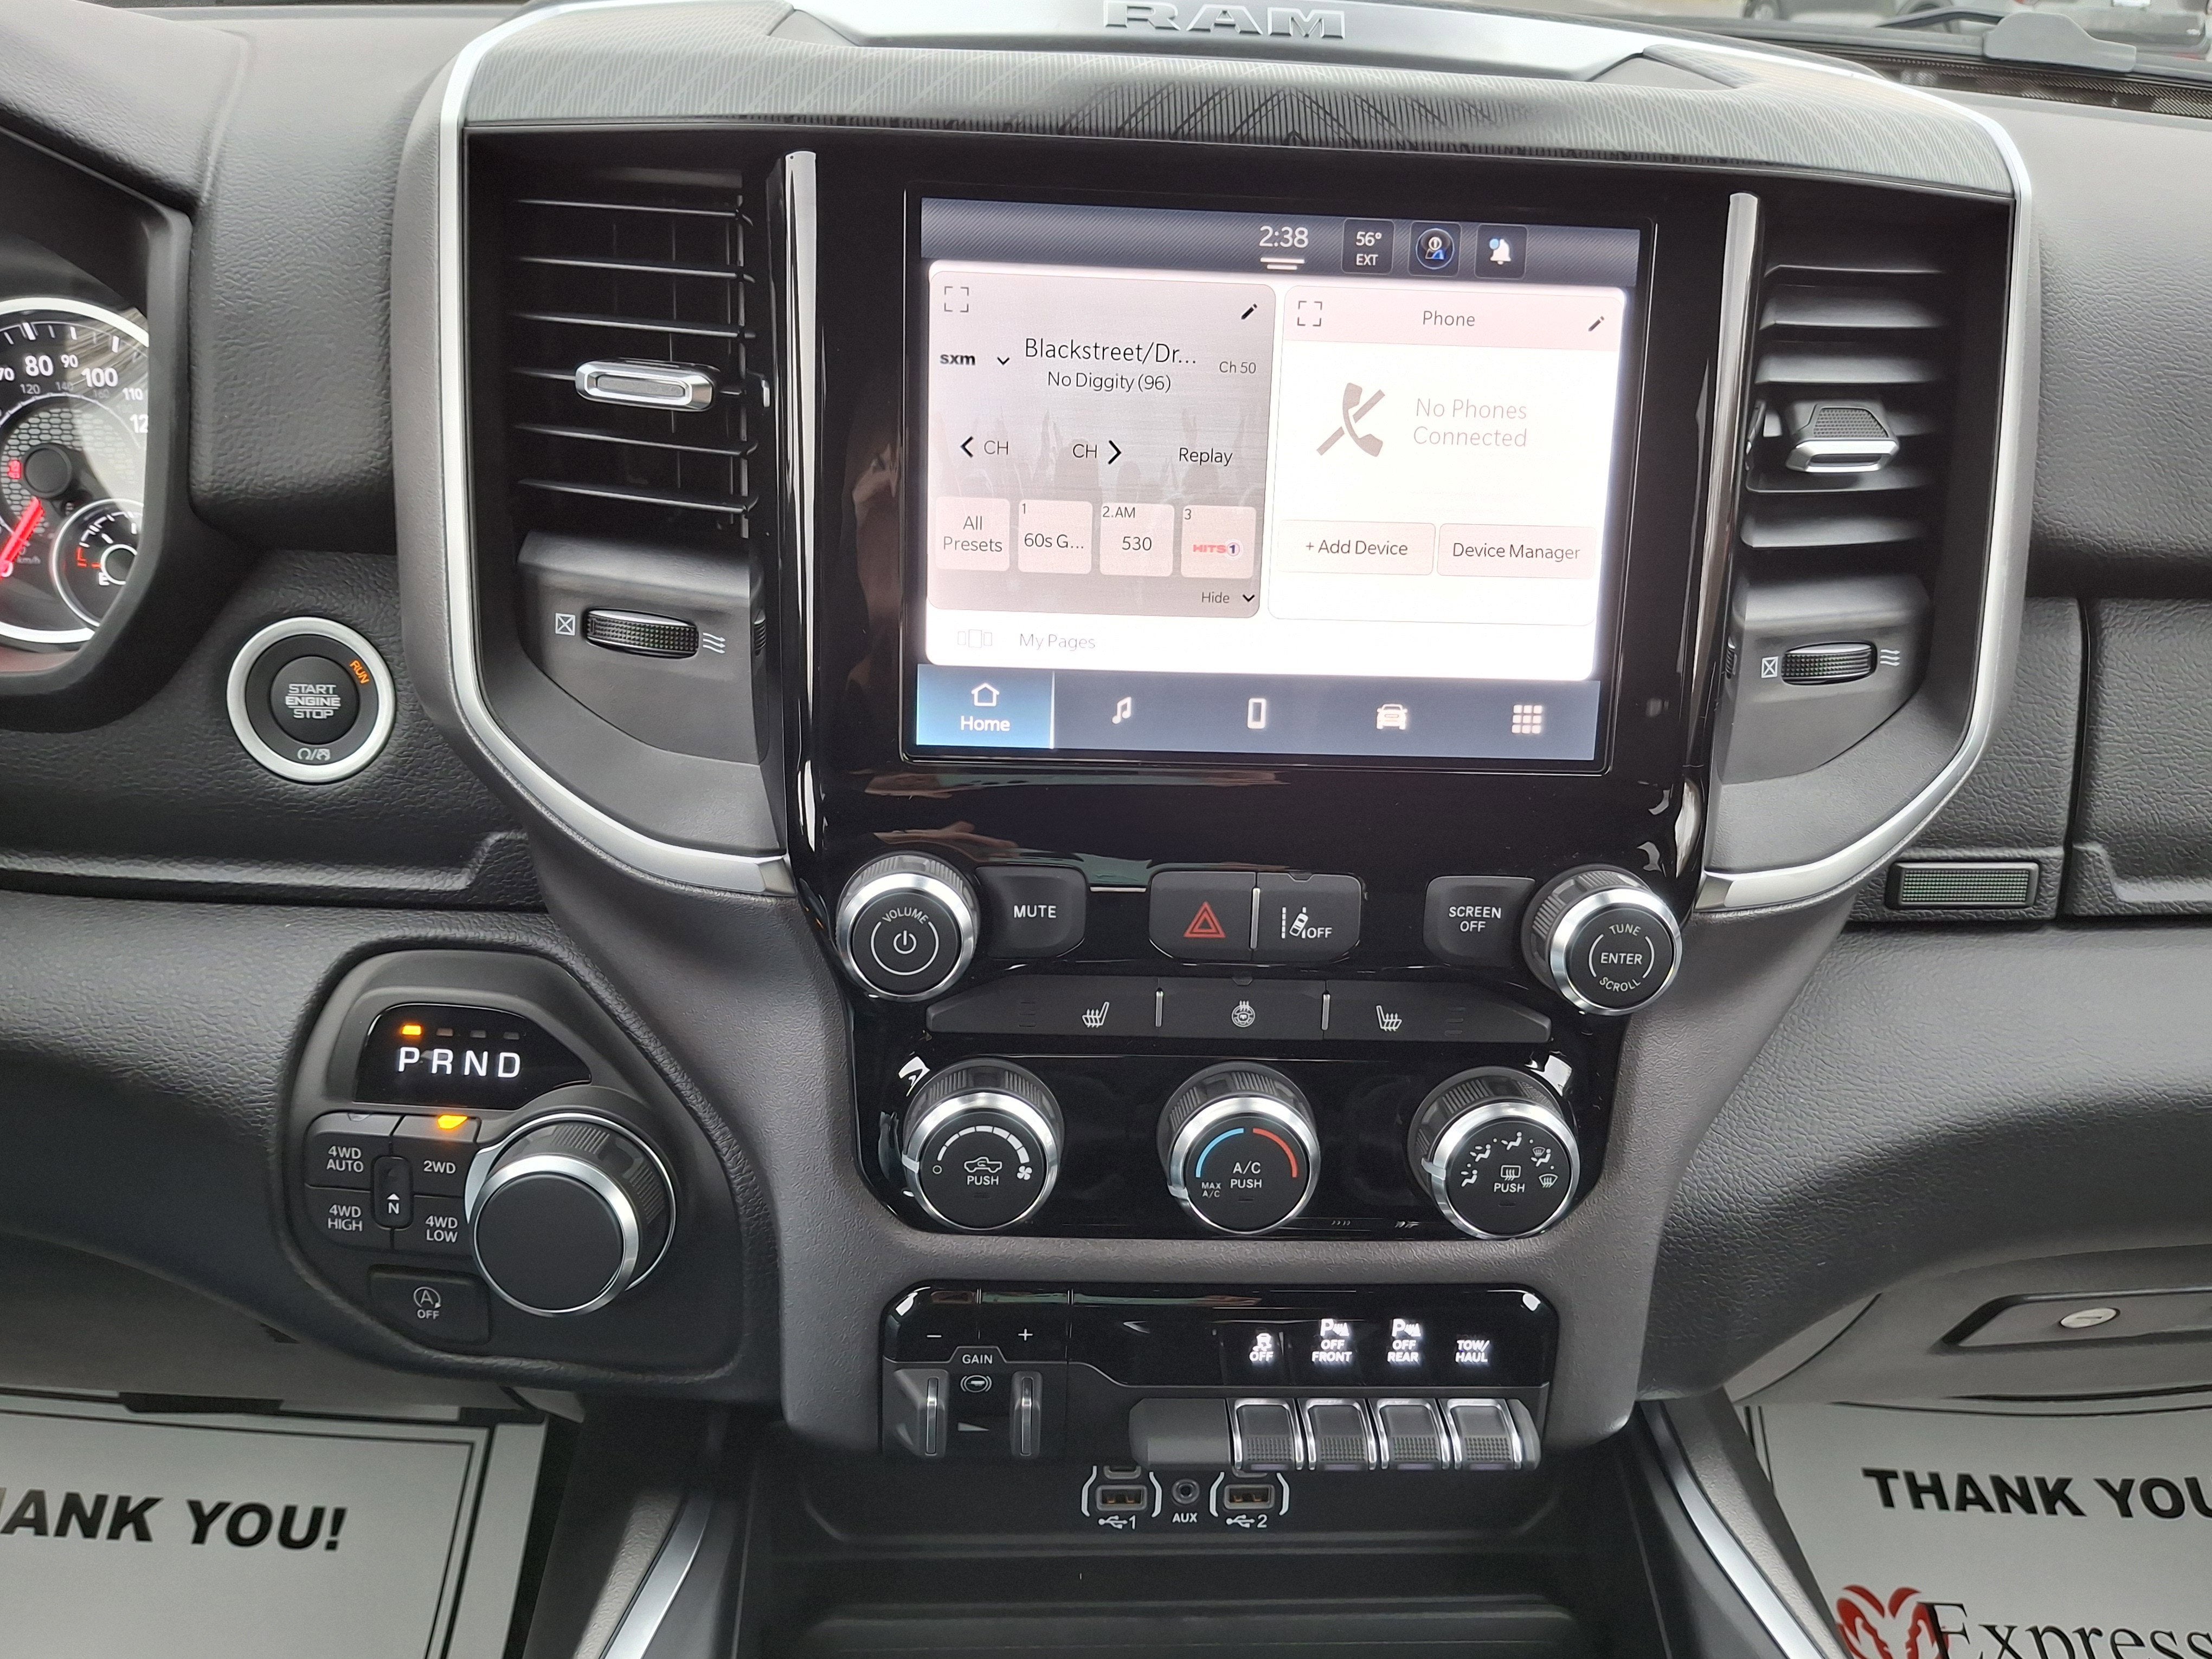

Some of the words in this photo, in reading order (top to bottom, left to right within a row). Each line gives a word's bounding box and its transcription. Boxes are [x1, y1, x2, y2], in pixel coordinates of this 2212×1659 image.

[1103, 0, 1345, 39] RAM
[1259, 226, 1309, 248] 2:38
[1355, 231, 1382, 247] 56°
[1355, 253, 1379, 266] EXT
[1422, 310, 1476, 326] Phone
[1024, 337, 1197, 364] Blackstreet/Dr...
[24, 355, 53, 376] 80
[61, 354, 79, 368] 90
[940, 353, 976, 366] sxm
[1219, 361, 1237, 374] Ch
[1239, 362, 1257, 375] 50
[81, 368, 118, 387] 100
[1047, 371, 1072, 387] No
[1075, 372, 1136, 393] Diggity
[1137, 374, 1172, 393] (96)
[20, 383, 41, 395] 120
[122, 387, 144, 401] 110
[1416, 398, 1445, 417] No
[1452, 399, 1527, 420] Phones
[1413, 426, 1527, 447] Connected
[983, 440, 1009, 455] CH
[1072, 443, 1097, 459] CH
[1179, 447, 1233, 466] Replay
[1021, 503, 1027, 515] 1
[1102, 505, 1136, 519] 2.AM
[1184, 509, 1192, 520] 3
[963, 516, 982, 531] All
[943, 536, 1002, 553] Presets
[1024, 532, 1052, 549] 60s
[1122, 536, 1152, 551] 530
[1318, 539, 1351, 555] Add
[1355, 541, 1408, 556] Device
[1452, 542, 1505, 558] Device
[1509, 543, 1581, 562] Manager
[1201, 591, 1230, 605] Hide
[1019, 633, 1043, 651] My
[1048, 634, 1096, 651] Pages
[349, 660, 370, 684] RUN
[288, 684, 337, 695] START
[285, 696, 341, 707] ENGINE
[293, 709, 334, 719] STOP
[960, 716, 1011, 732] Home
[882, 906, 929, 924] VOLUME
[1013, 904, 1057, 918] MUTE
[1448, 906, 1502, 919] SCREEN
[1307, 927, 1333, 938] OFF
[1459, 921, 1486, 932] OFF
[1609, 923, 1642, 936] TUNE
[1600, 952, 1643, 966] ENTER
[1599, 976, 1642, 992] SCROLL
[327, 1146, 361, 1159] 4WD
[326, 1159, 364, 1173] AUTO
[423, 1160, 456, 1174] 2WD
[1232, 1160, 1261, 1175] A/C
[967, 1175, 999, 1186] PUSH
[1230, 1179, 1262, 1189] PUSH
[1493, 1182, 1526, 1193] PUSH
[1202, 1189, 1220, 1199] A/C
[329, 1204, 362, 1218] 4WD
[388, 1202, 400, 1214] N
[327, 1218, 363, 1232] HIGH
[425, 1216, 458, 1230] 4WD
[426, 1229, 458, 1243] LOW
[417, 1309, 440, 1319] OFF
[1321, 1339, 1345, 1351] OFF
[1392, 1339, 1416, 1351] OFF
[1456, 1340, 1490, 1352] TOW/
[962, 1354, 993, 1365] GAIN
[1249, 1351, 1274, 1362] OFF
[1311, 1351, 1352, 1362] FRONT
[1387, 1351, 1419, 1362] REAR
[1455, 1352, 1488, 1363] HAUL
[1861, 1467, 2087, 1517] THANK
[0, 1487, 164, 1543] ANK
[186, 1499, 348, 1551] YOU!
[1129, 1515, 1136, 1529] 1
[1172, 1512, 1198, 1523] AUX
[1257, 1514, 1268, 1528] 2
